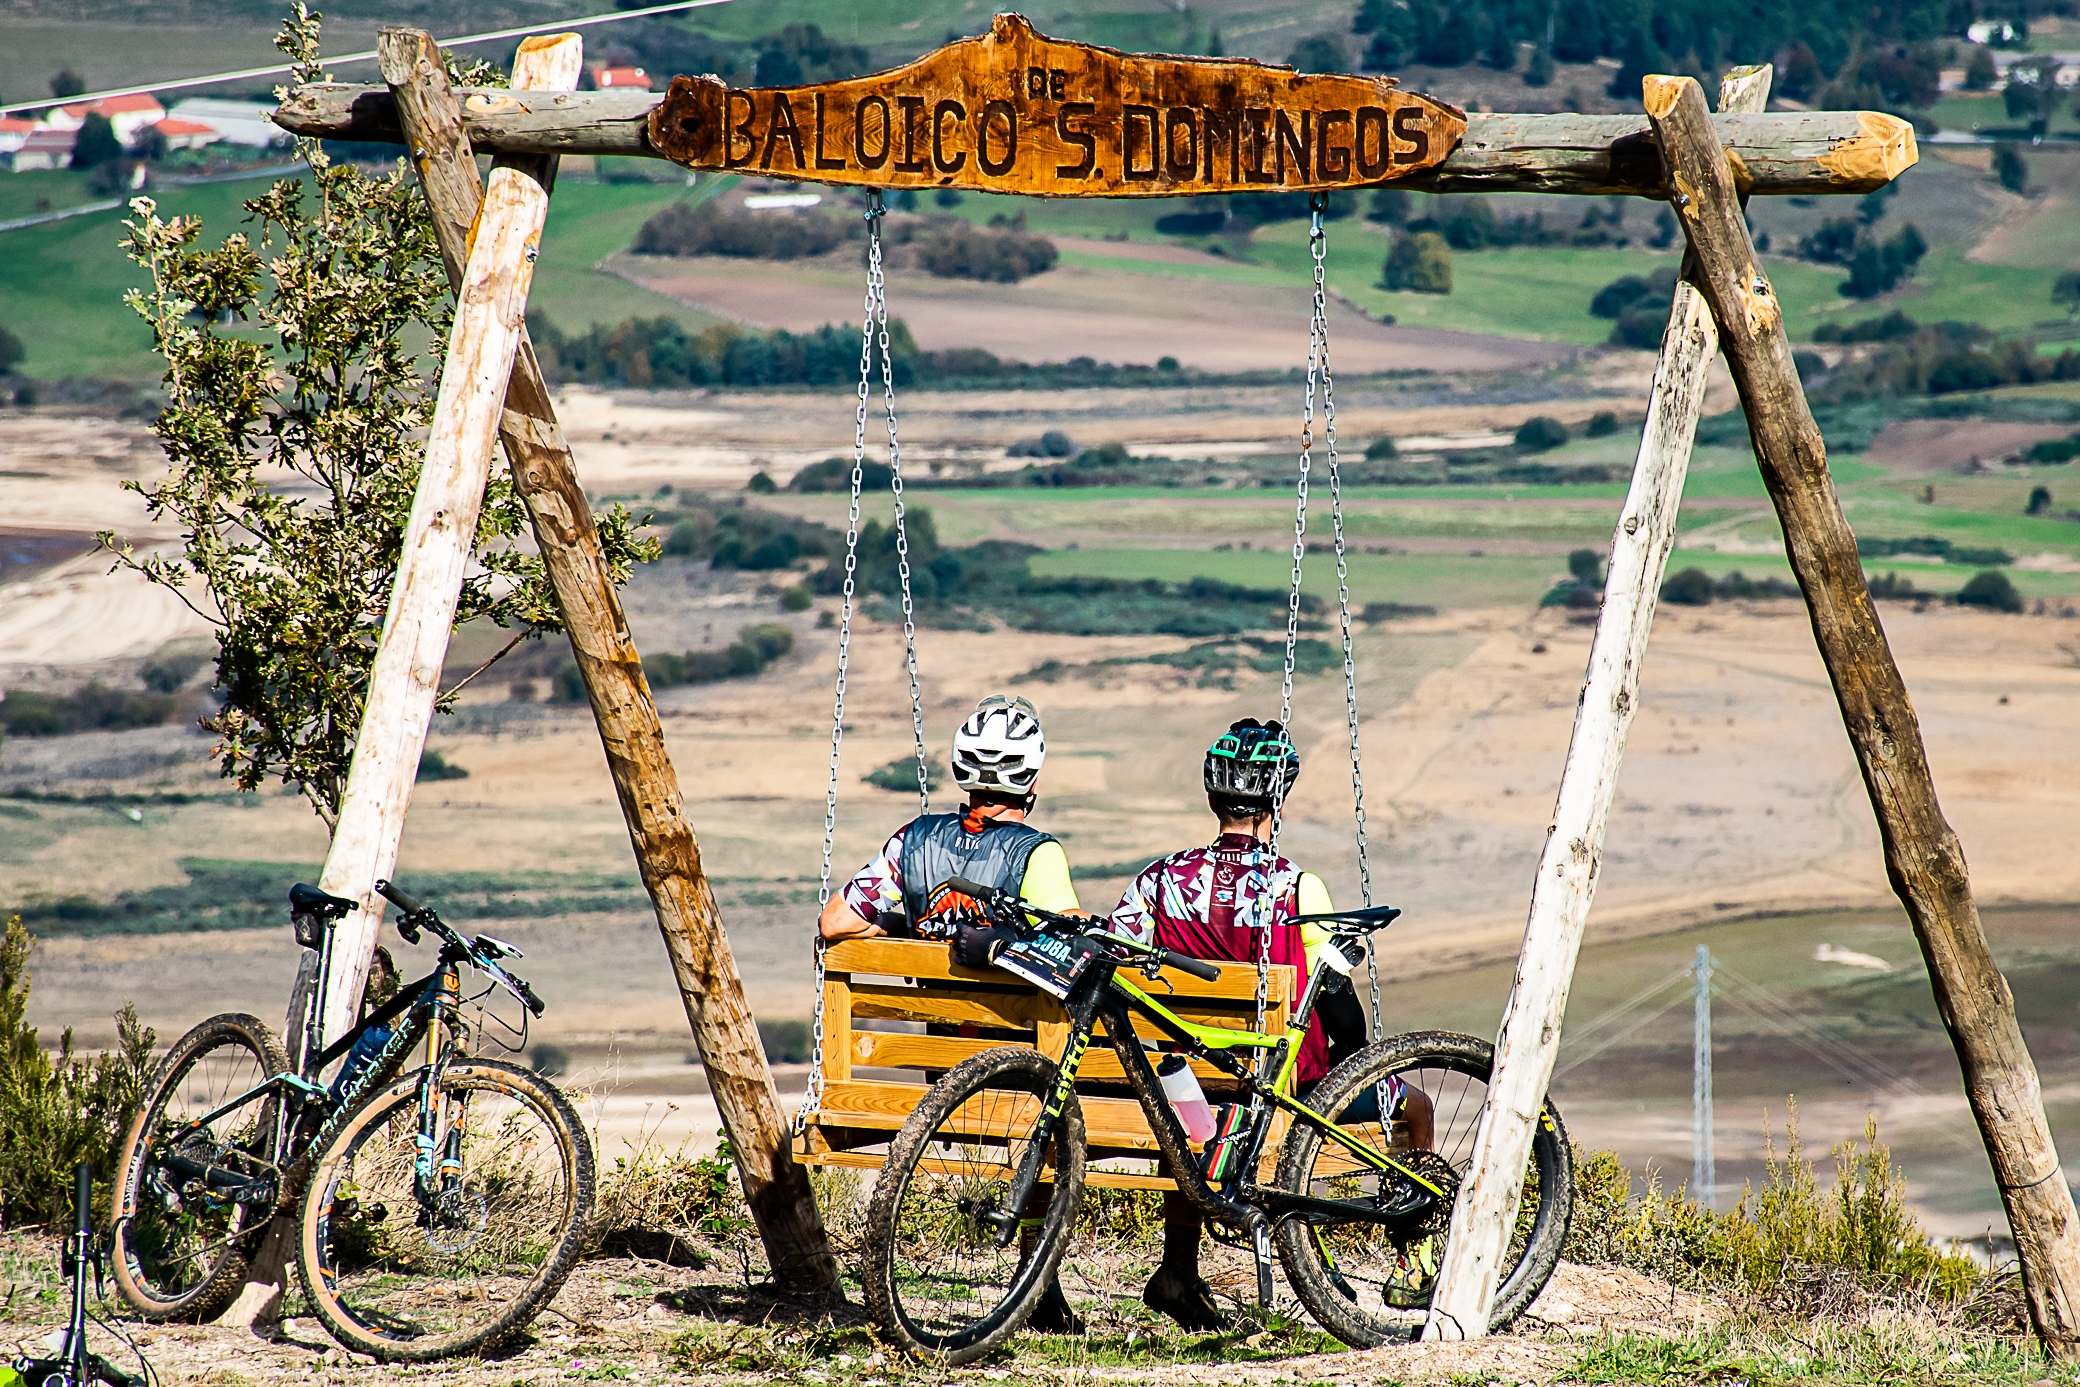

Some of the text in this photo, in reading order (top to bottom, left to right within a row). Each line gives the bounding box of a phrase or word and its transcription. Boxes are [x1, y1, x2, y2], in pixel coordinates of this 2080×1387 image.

[1026, 66, 1066, 100] DE
[1055, 102, 1104, 179] S.
[1121, 105, 1430, 185] DOMINGOS
[1031, 933, 1072, 963] 308A
